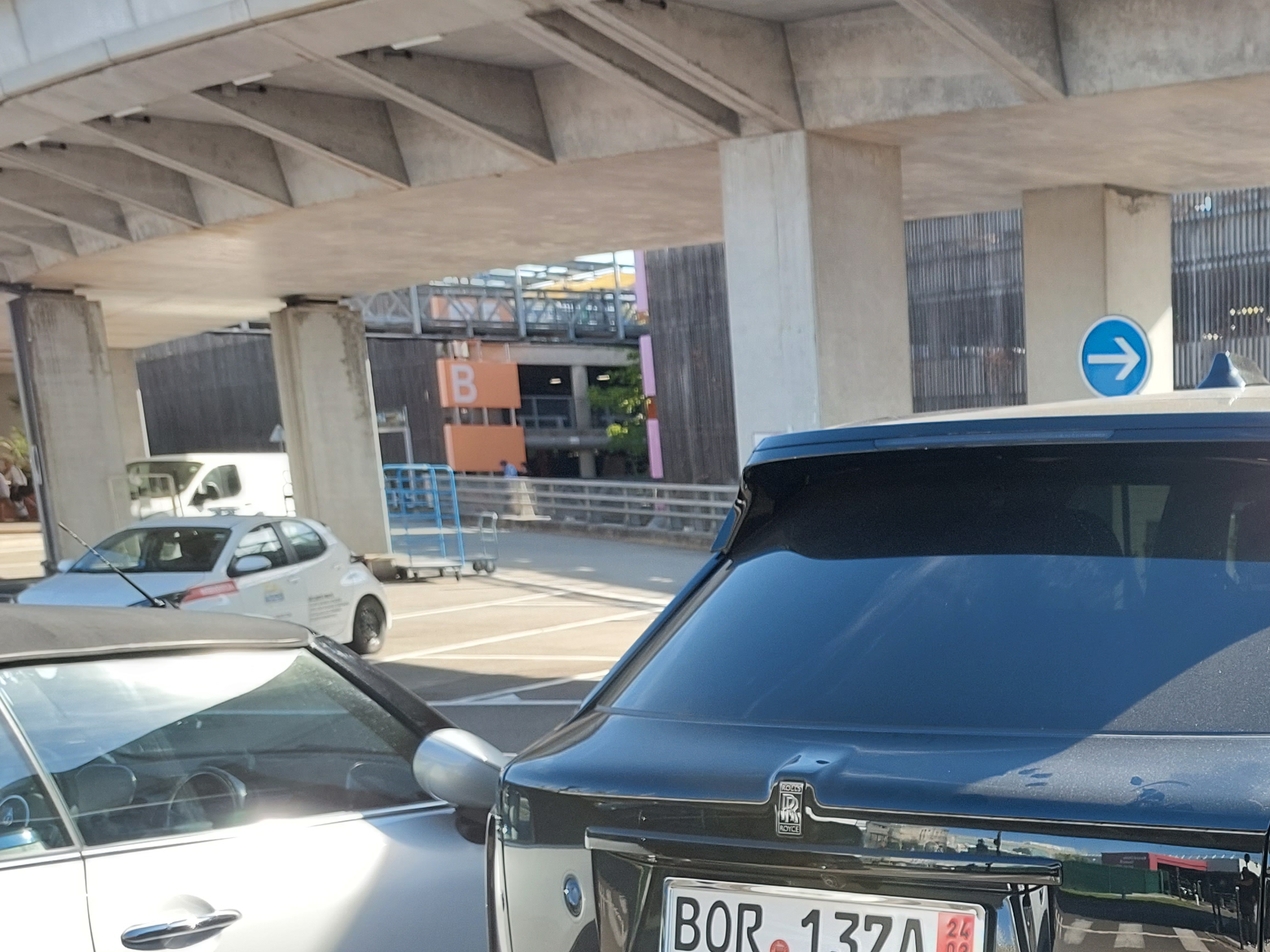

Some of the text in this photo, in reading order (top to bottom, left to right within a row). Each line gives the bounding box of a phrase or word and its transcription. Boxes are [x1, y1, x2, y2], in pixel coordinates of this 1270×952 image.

[451, 364, 478, 404] B
[781, 783, 802, 792] ROLLS
[780, 824, 800, 833] ROYCE
[946, 917, 970, 940] 24
